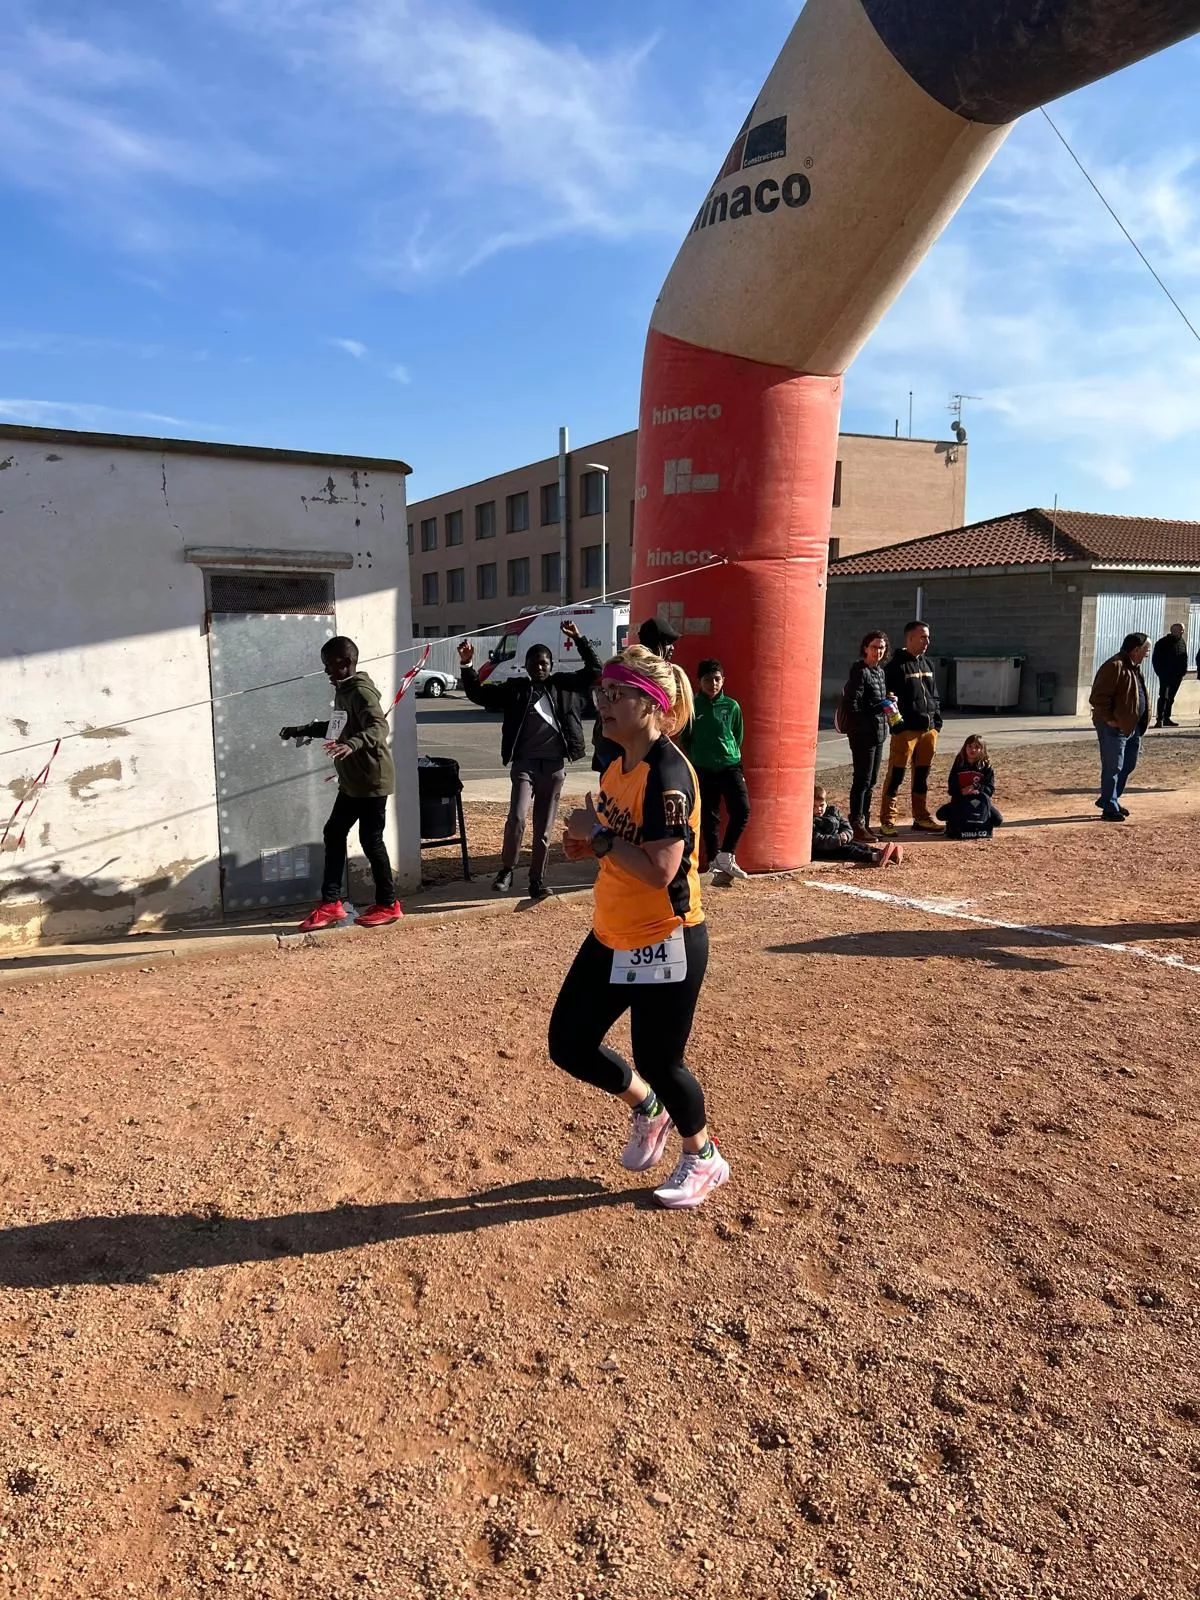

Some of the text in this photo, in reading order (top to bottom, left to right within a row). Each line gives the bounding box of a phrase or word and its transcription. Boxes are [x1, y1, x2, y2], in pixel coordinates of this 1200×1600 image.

[652, 403, 722, 425] hinaco
[646, 549, 713, 567] hinaco
[630, 943, 668, 965] 394
